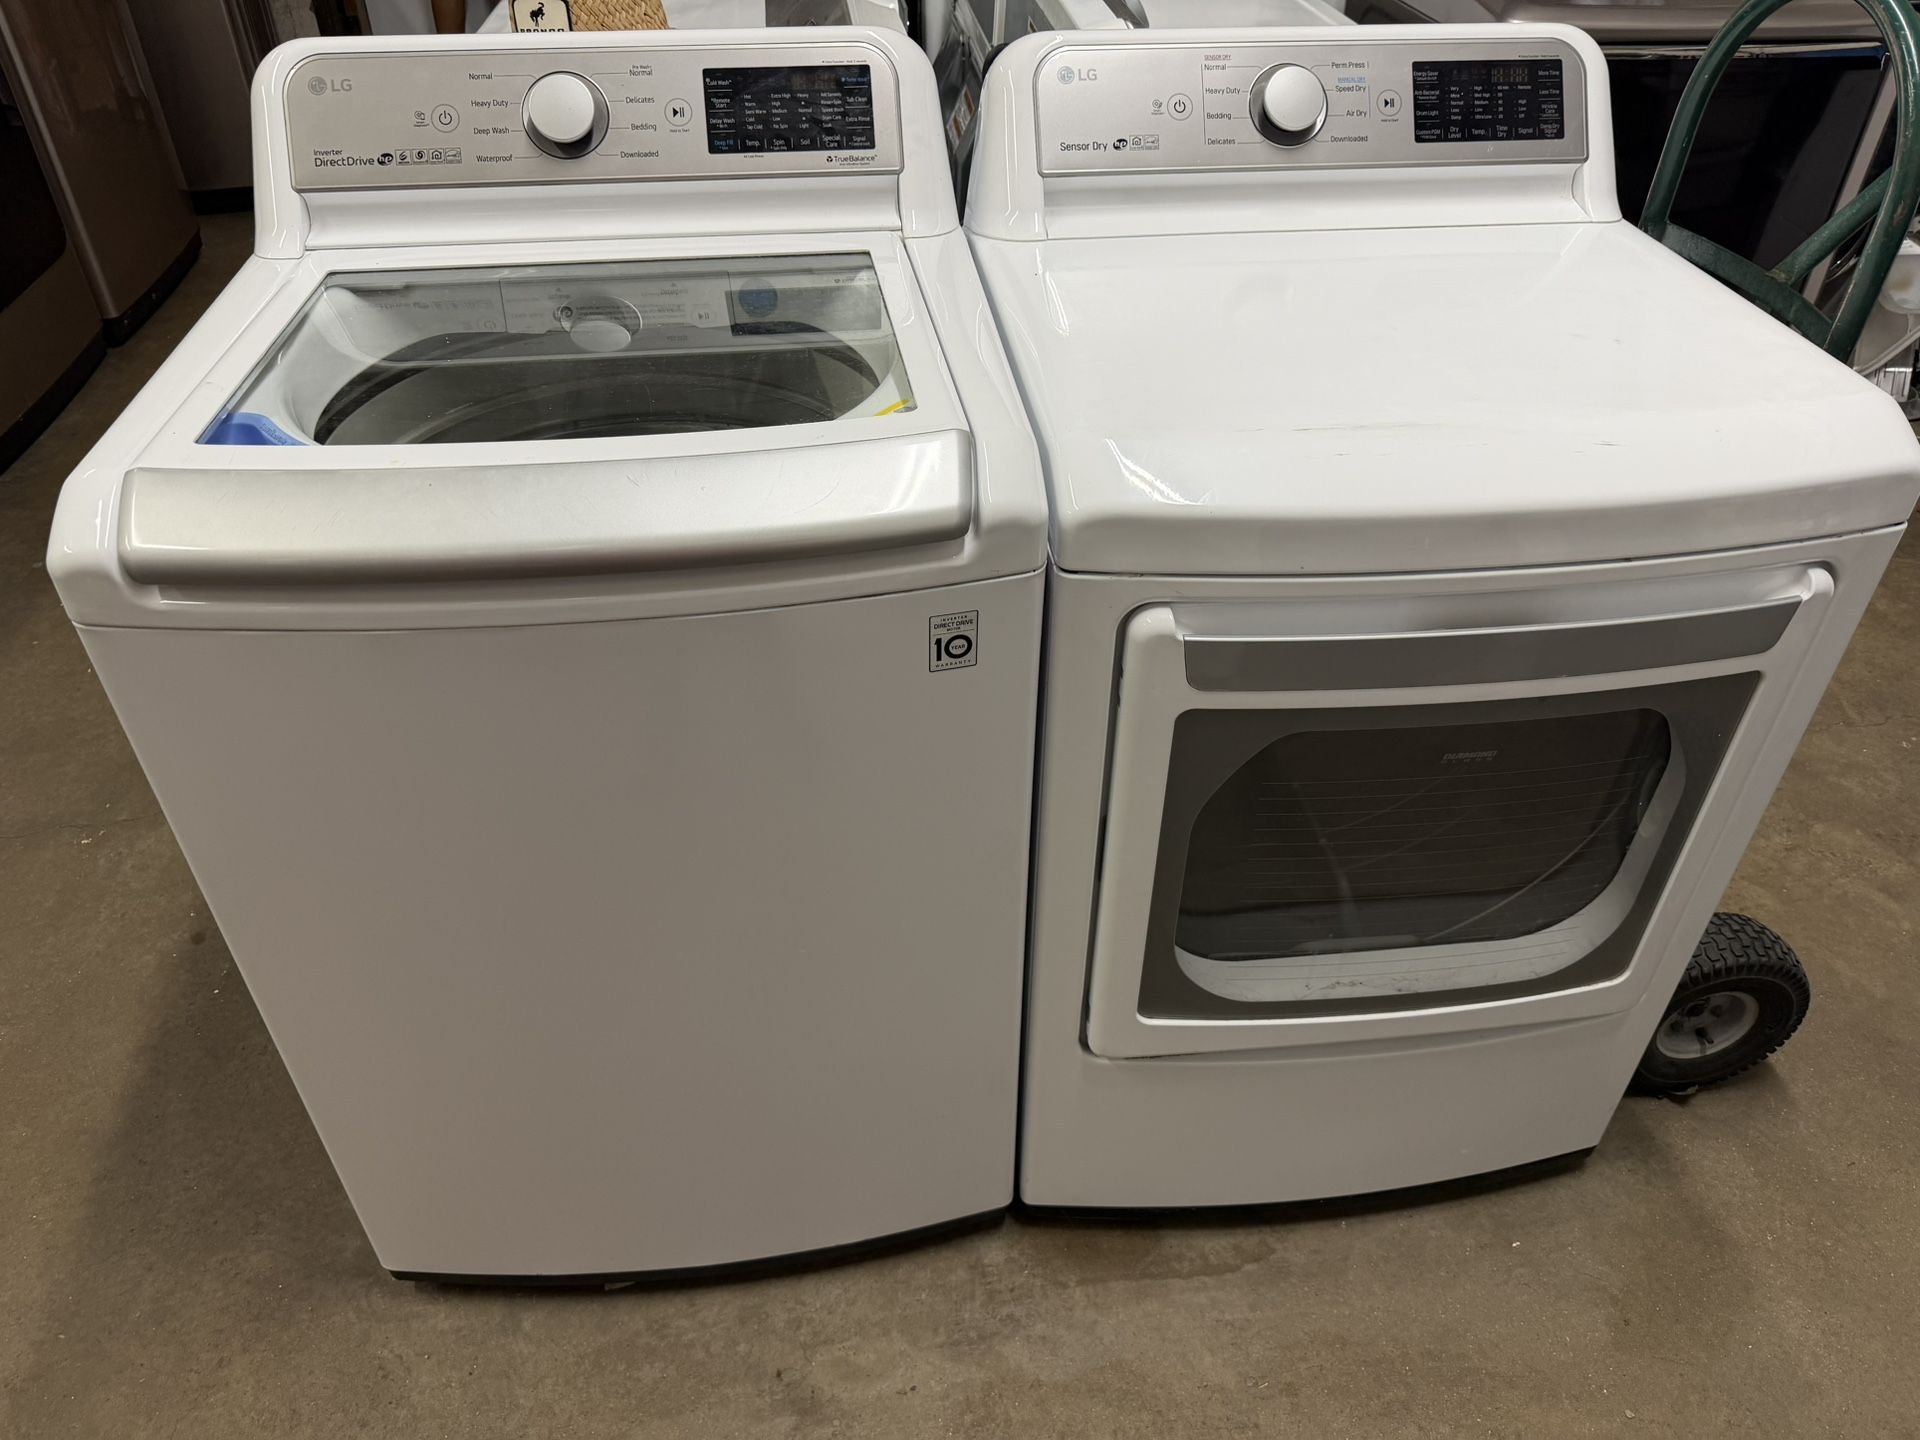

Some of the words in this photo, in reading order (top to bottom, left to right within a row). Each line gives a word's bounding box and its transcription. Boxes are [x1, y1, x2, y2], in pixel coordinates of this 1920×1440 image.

[1078, 68, 1098, 81] LG
[331, 78, 352, 92] LG
[471, 100, 491, 109] Heavy
[492, 99, 509, 108] Duty
[1207, 112, 1232, 120] Bedding
[473, 128, 490, 136] Deep
[492, 126, 510, 134] Wash
[631, 123, 656, 132] Bedding
[1060, 142, 1090, 152] Sensor
[1092, 141, 1108, 152] Dry
[476, 154, 513, 164] Waterproof
[620, 150, 659, 158] Downloaded
[934, 634, 972, 661] 10
